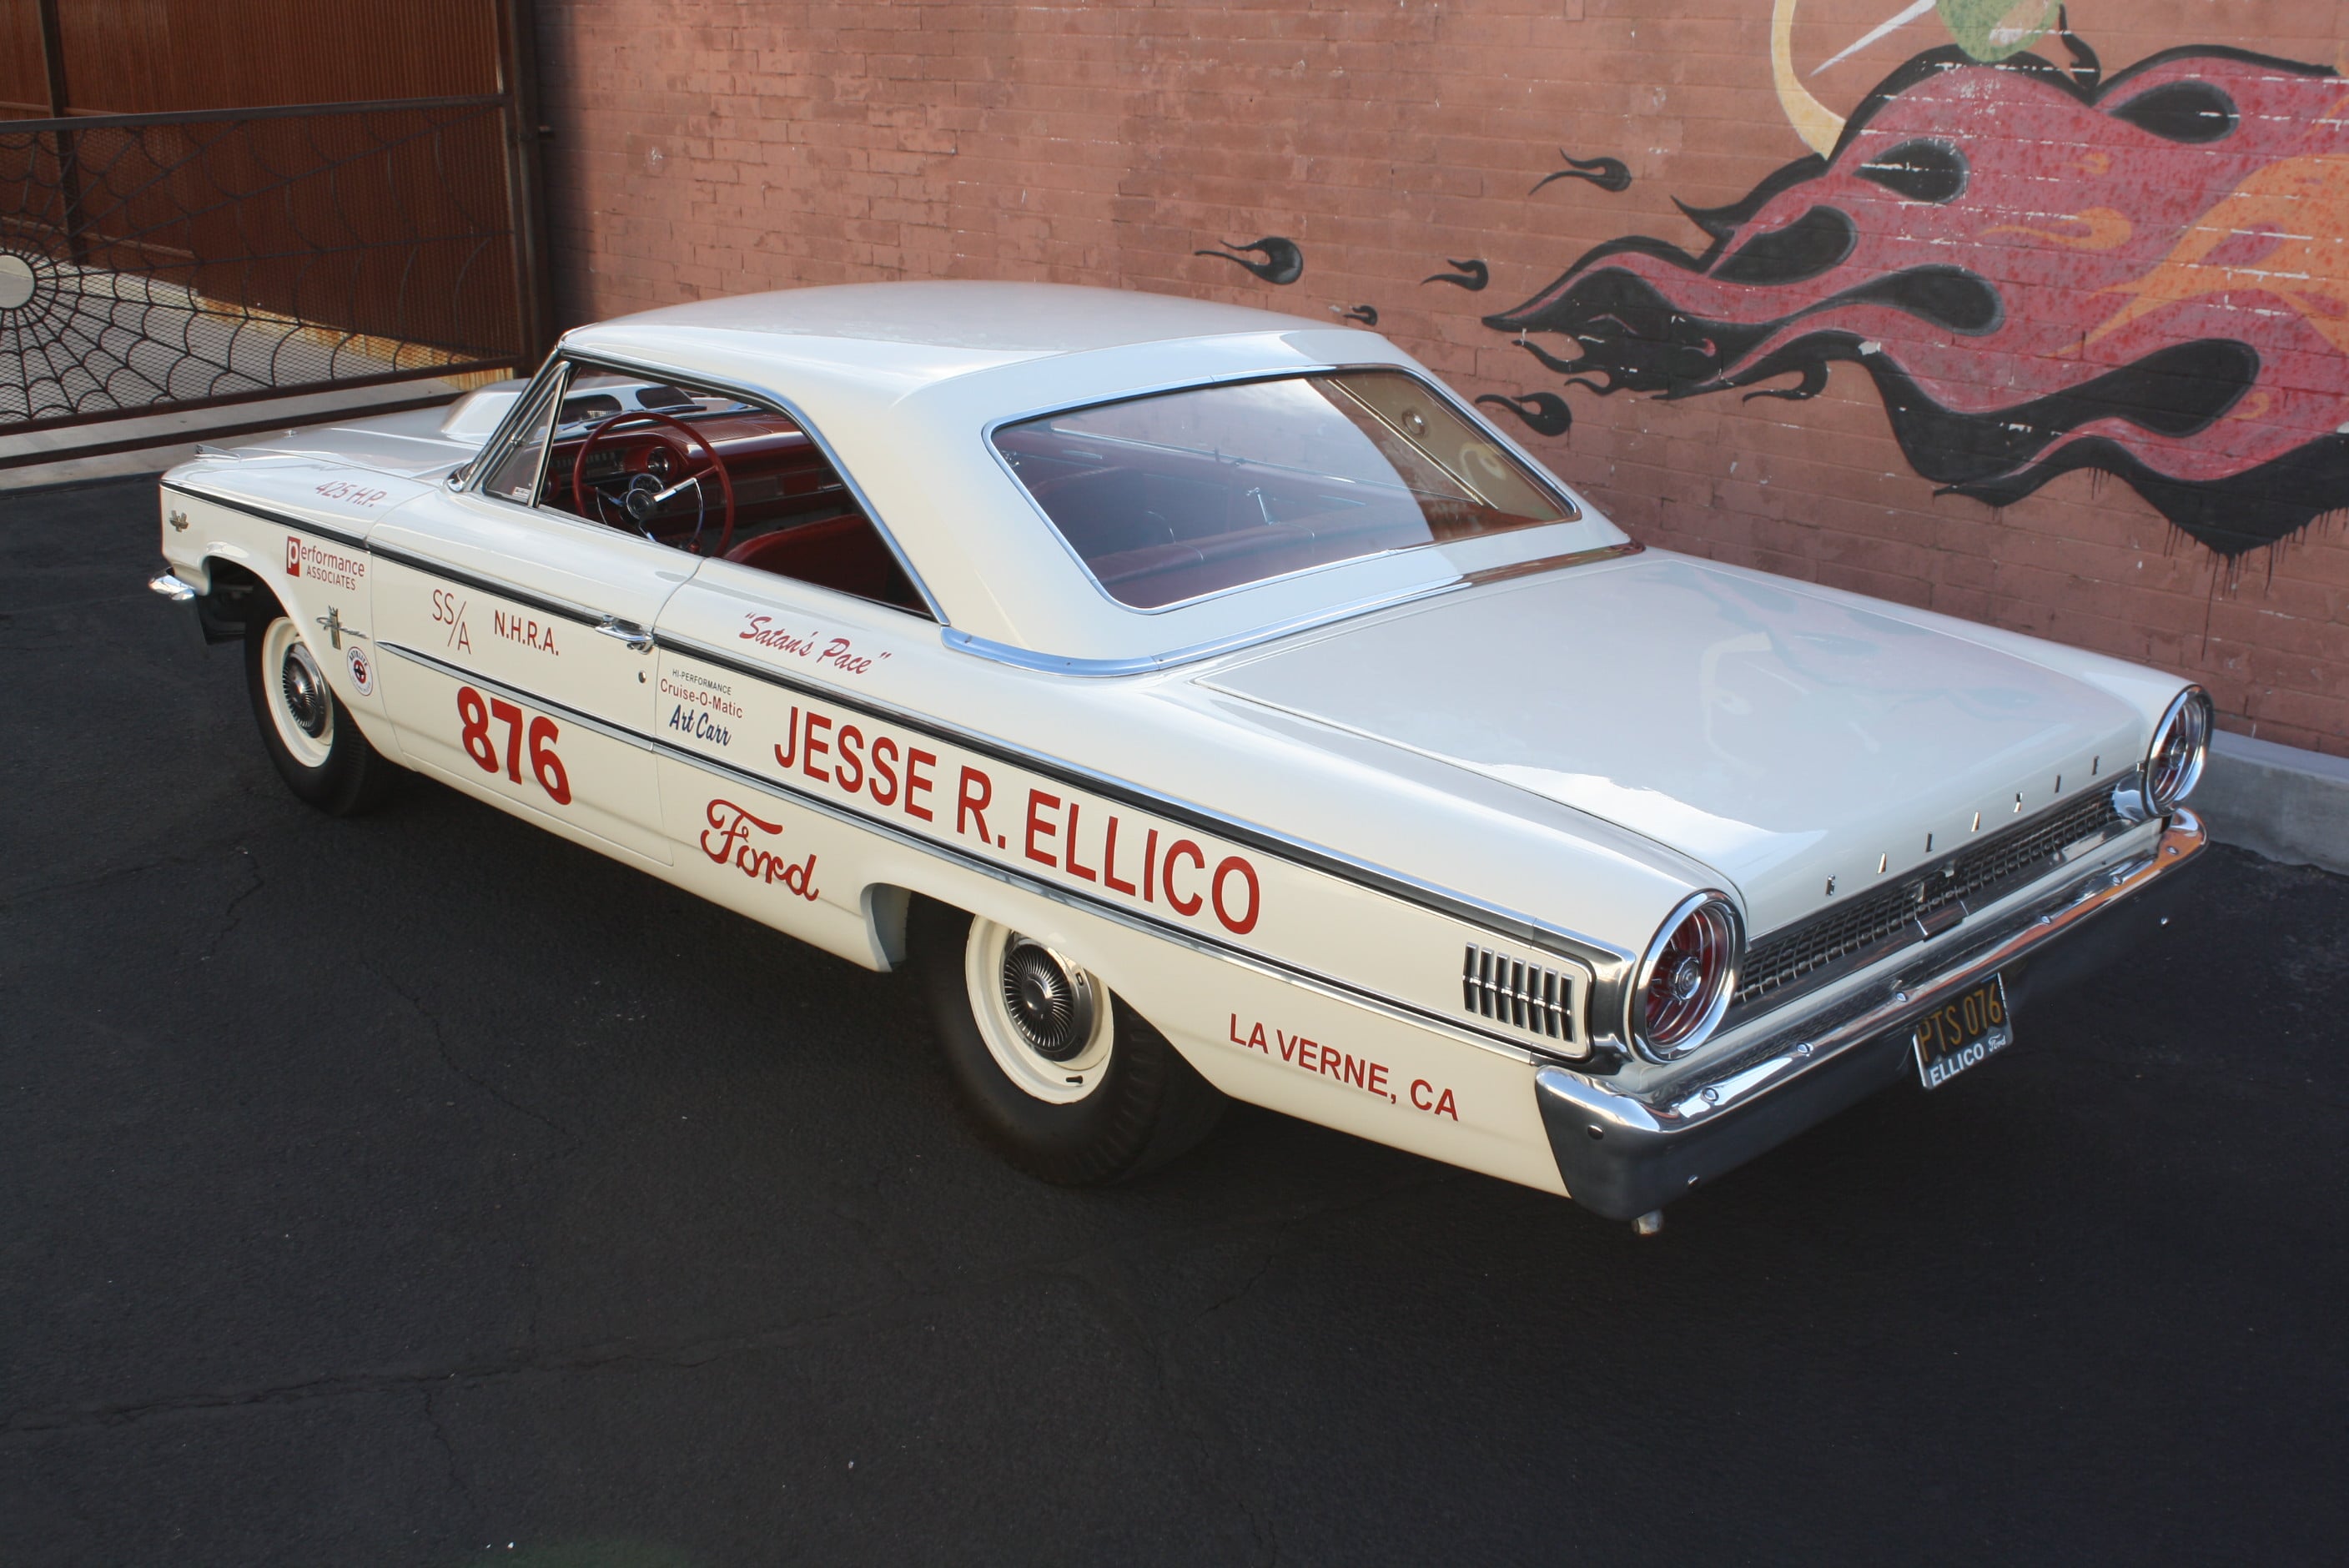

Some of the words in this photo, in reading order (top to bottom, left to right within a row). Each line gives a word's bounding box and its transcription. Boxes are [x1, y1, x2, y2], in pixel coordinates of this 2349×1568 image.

[315, 480, 358, 499] 425
[288, 539, 365, 577] performance
[306, 565, 356, 591] ASSOCIATES
[495, 610, 559, 656] N.H.R.A.
[739, 612, 819, 657] "Satan's
[817, 638, 892, 674] Pace"
[660, 678, 742, 718] Cruise-O-Matic
[672, 668, 732, 696] HI-PERFORMANCE
[457, 686, 571, 806] 876
[669, 704, 695, 733] Art
[696, 712, 732, 746] Carr
[774, 706, 937, 822] JESSE
[957, 765, 1006, 850] R.
[1025, 788, 1260, 935] ELLICO
[700, 798, 820, 902] Ford
[1917, 1005, 1963, 1063] PTS
[1963, 983, 2003, 1036] 076
[1230, 1013, 1269, 1054] LA
[1276, 1029, 1396, 1105] VERNE,
[1410, 1078, 1460, 1122] CA
[1929, 1043, 1984, 1087] ELLICO
[1988, 1033, 2007, 1053] Ford
